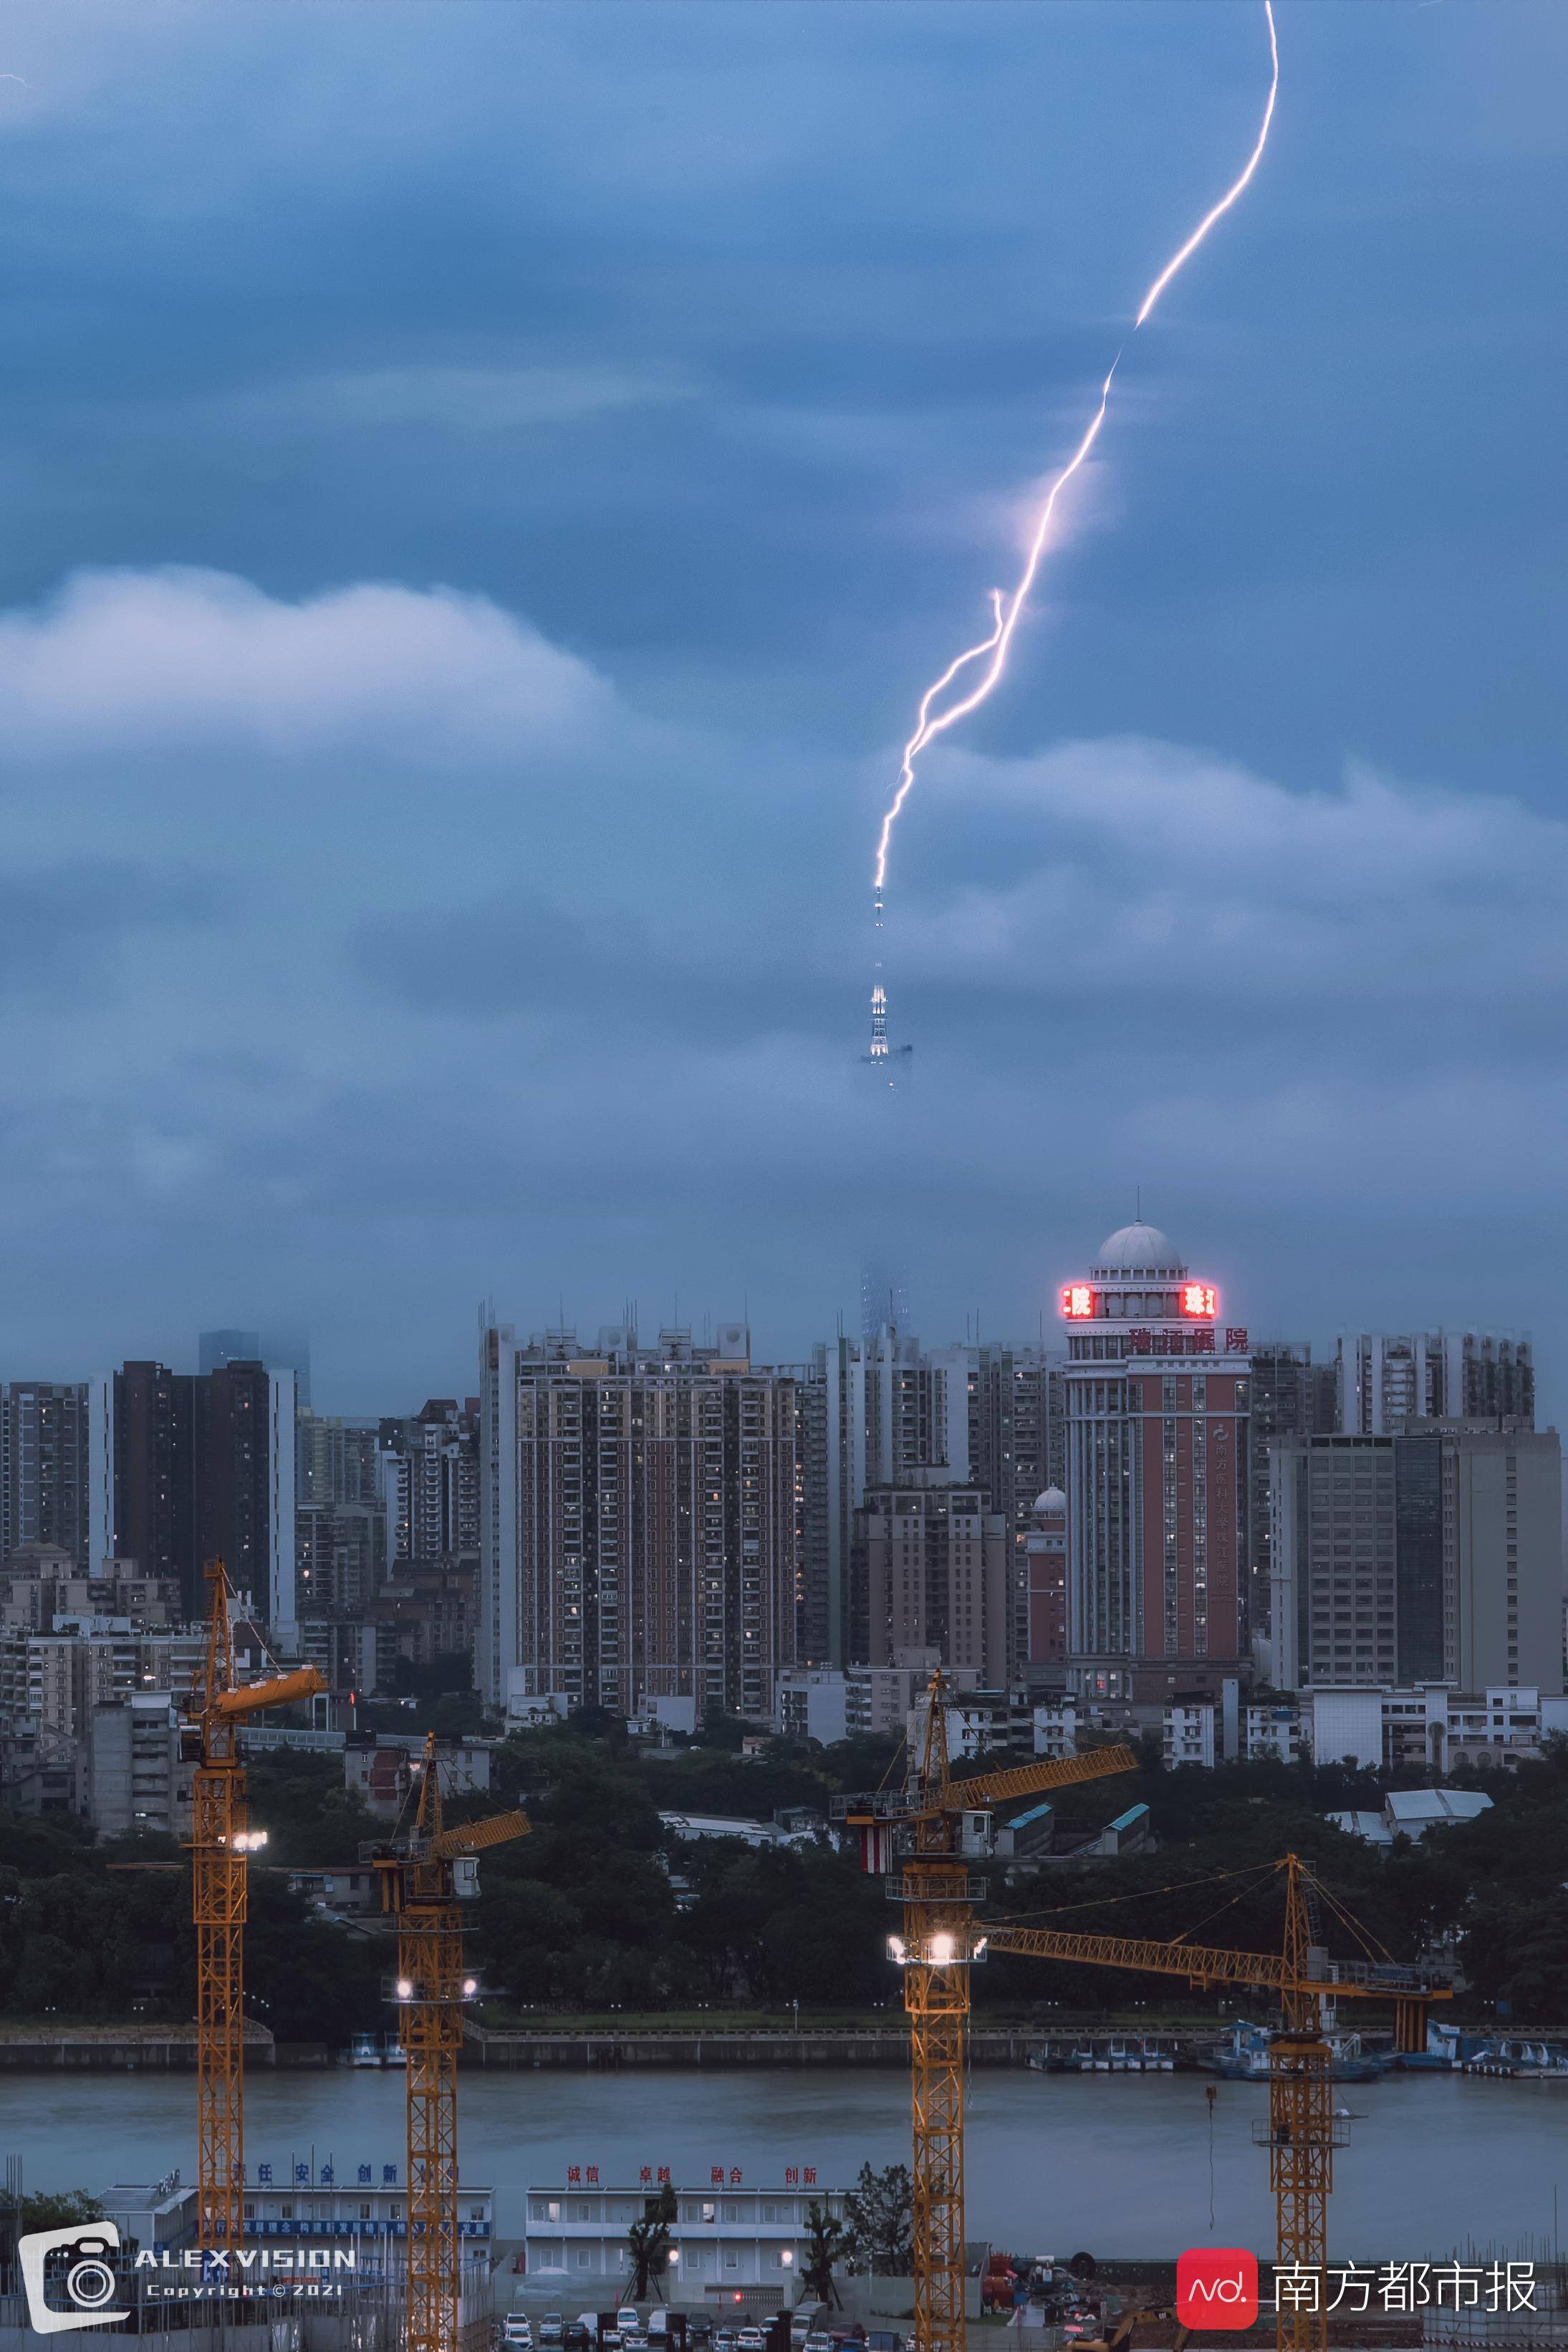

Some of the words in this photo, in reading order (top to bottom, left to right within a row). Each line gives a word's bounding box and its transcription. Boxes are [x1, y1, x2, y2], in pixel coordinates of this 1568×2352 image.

[1216, 1444, 1228, 1588] 南方医科大学珠江医院
[295, 2163, 334, 2182] 安全
[358, 2164, 397, 2183] 创新
[567, 2166, 600, 2184] 诚信
[640, 2166, 671, 2183] 卓越
[711, 2166, 743, 2184] 融合
[785, 2166, 817, 2184] 创新
